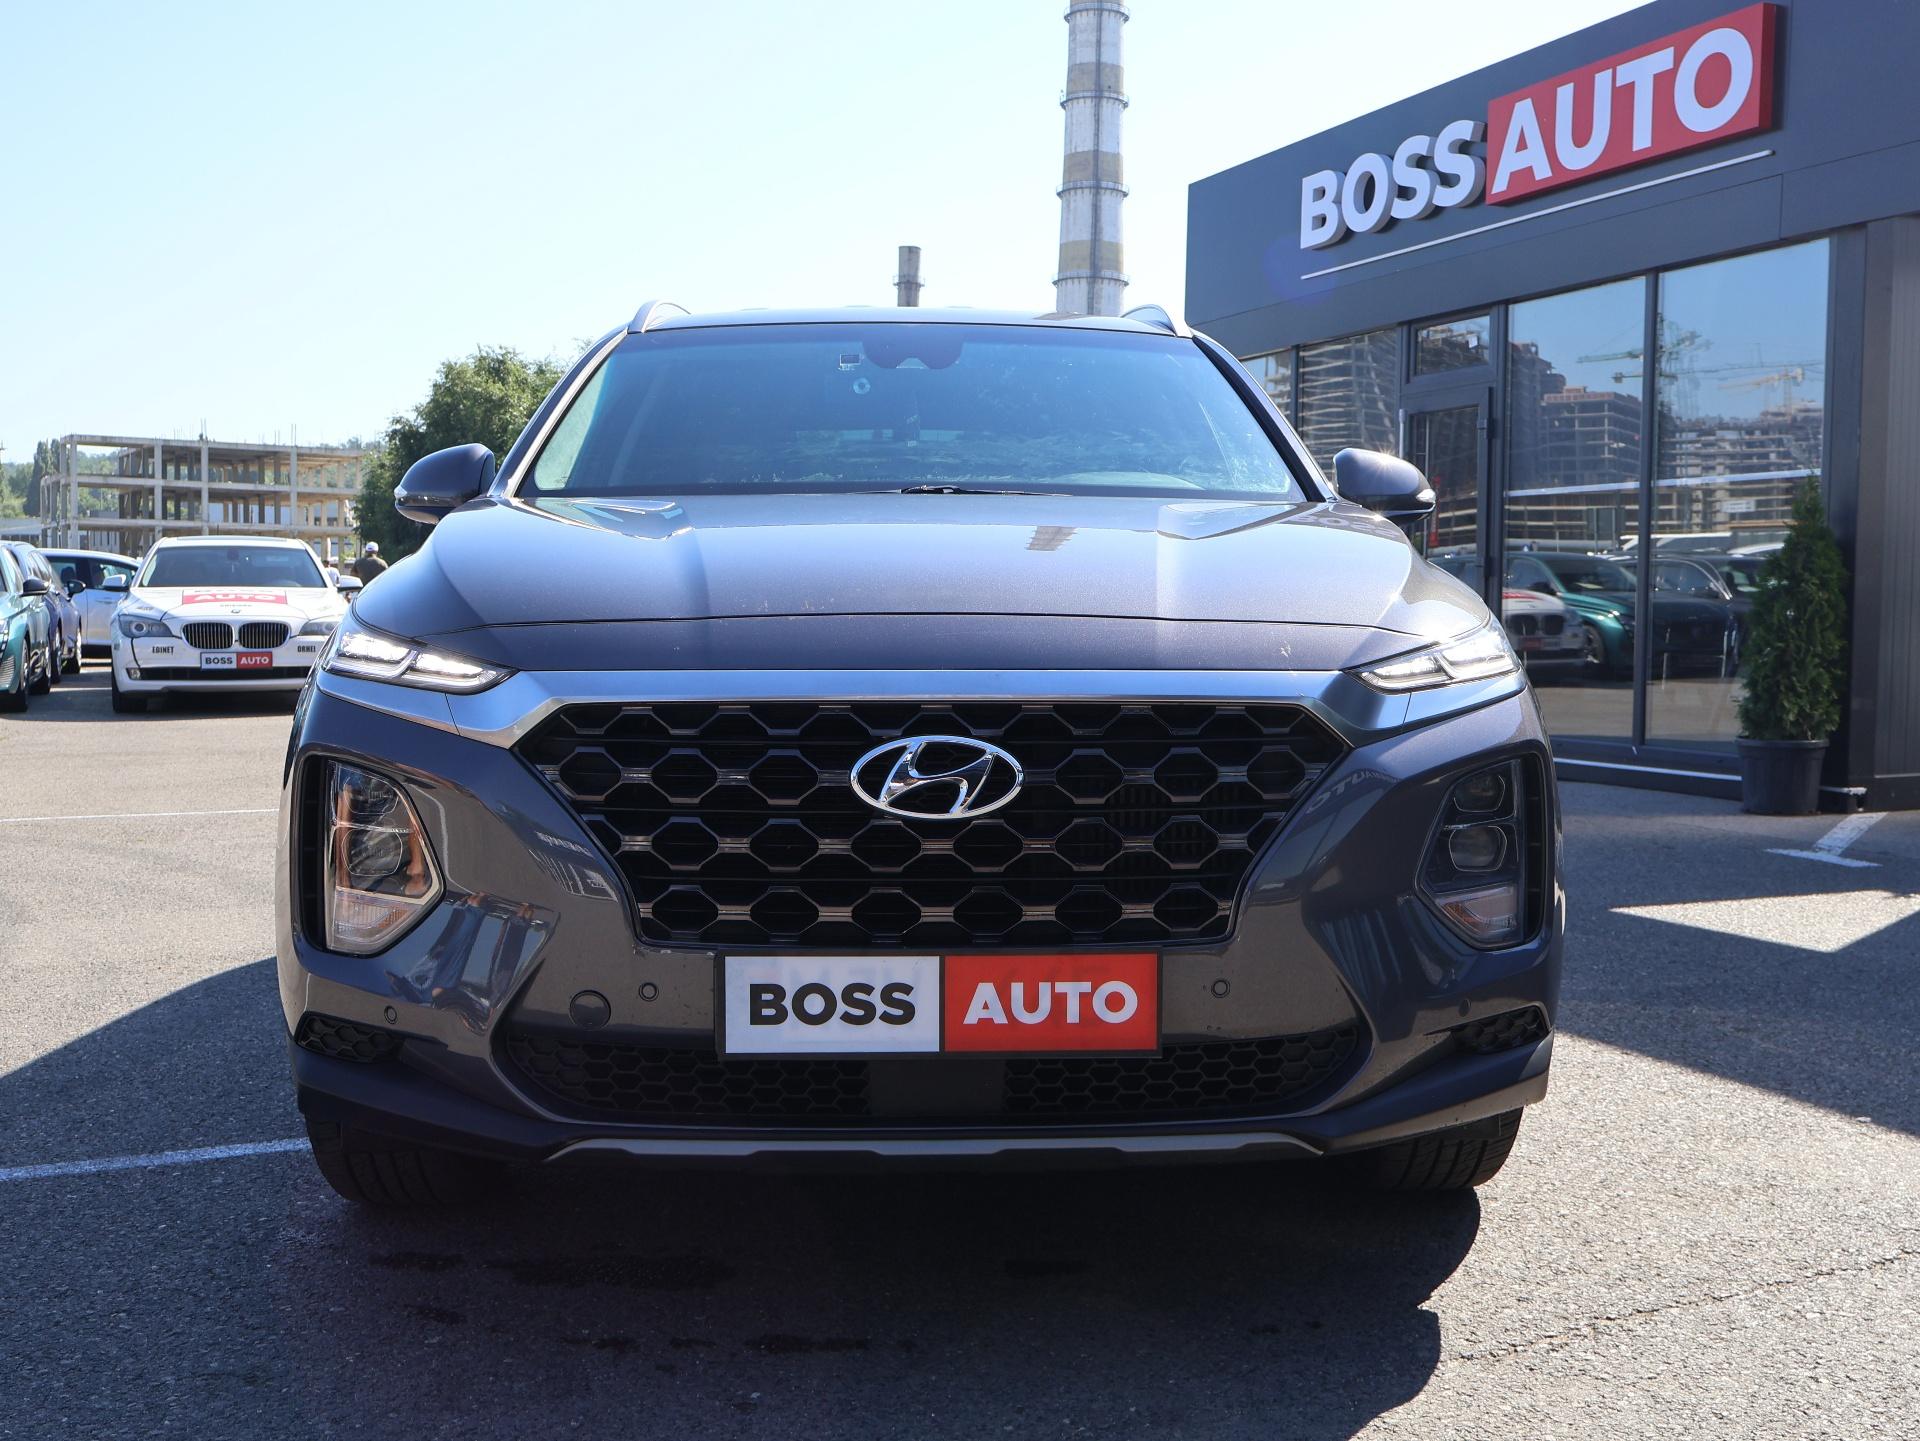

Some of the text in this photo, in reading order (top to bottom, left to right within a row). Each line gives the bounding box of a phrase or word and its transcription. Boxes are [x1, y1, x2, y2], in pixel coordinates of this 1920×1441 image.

[1300, 27, 1754, 249] BOSS AUTO
[194, 593, 276, 601] AUTO
[205, 656, 269, 665] BOSS AUTO
[749, 982, 916, 1026] BOSS
[962, 980, 1138, 1025] AUTO
